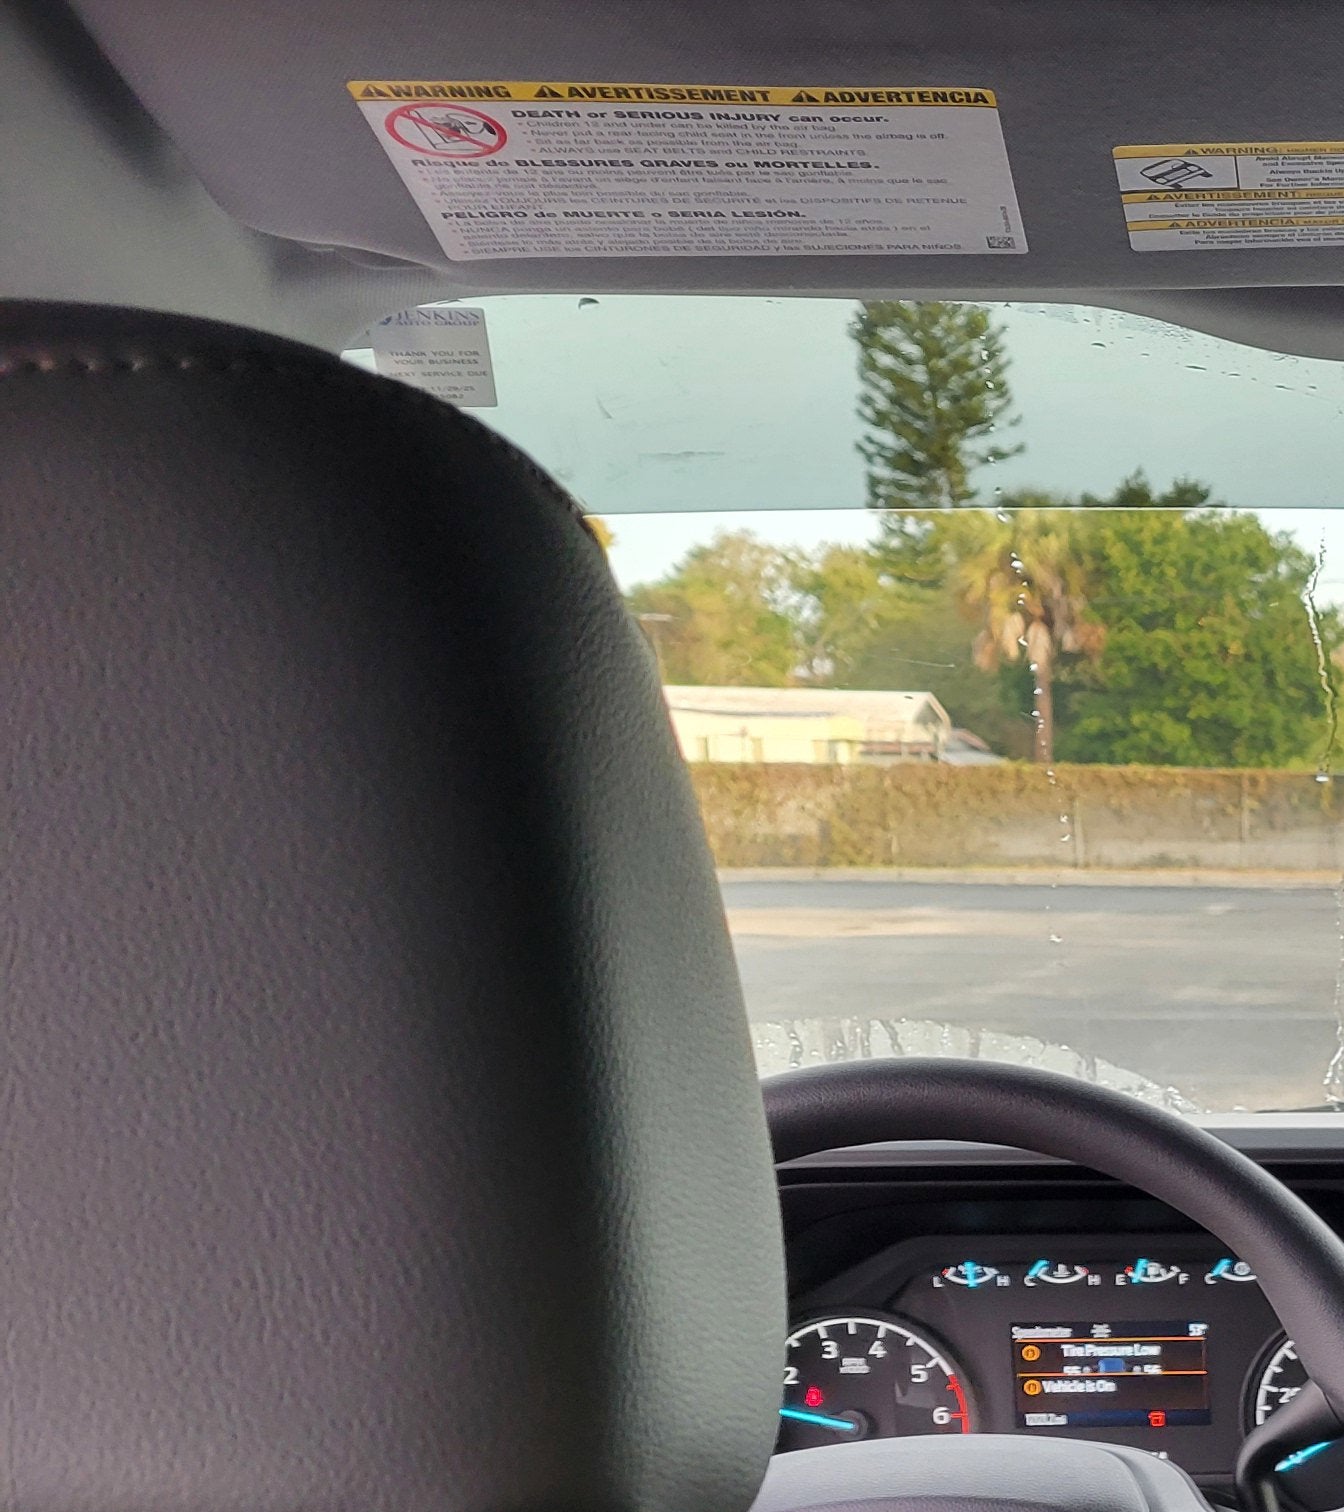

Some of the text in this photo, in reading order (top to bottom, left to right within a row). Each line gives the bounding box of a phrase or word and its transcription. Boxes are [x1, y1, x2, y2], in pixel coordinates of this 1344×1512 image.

[389, 85, 989, 104] WARNING AVERTISSEMENT ADVERTENCIA
[511, 110, 581, 118] DEATH
[613, 111, 704, 119] SERIOUS
[709, 112, 781, 121] INJURY
[829, 115, 889, 123] occur.
[412, 159, 880, 169] Risque de BLESSURES GRAVES ou MORTELLES.
[441, 211, 528, 220] PELIGRO
[534, 211, 559, 219] de
[562, 211, 645, 219] MUERTE
[667, 210, 726, 218] SERIA
[932, 1276, 944, 1288] L
[996, 1275, 1011, 1287] H
[1087, 1274, 1102, 1286] H
[1115, 1274, 1127, 1286] E
[1177, 1273, 1189, 1286] F
[820, 1341, 839, 1360] 3
[868, 1341, 888, 1359] 4
[783, 1366, 800, 1385] 2
[910, 1364, 929, 1383] 5
[1041, 1379, 1084, 1394] Vehicle
[1096, 1380, 1118, 1393] On
[932, 1406, 951, 1425] 6
